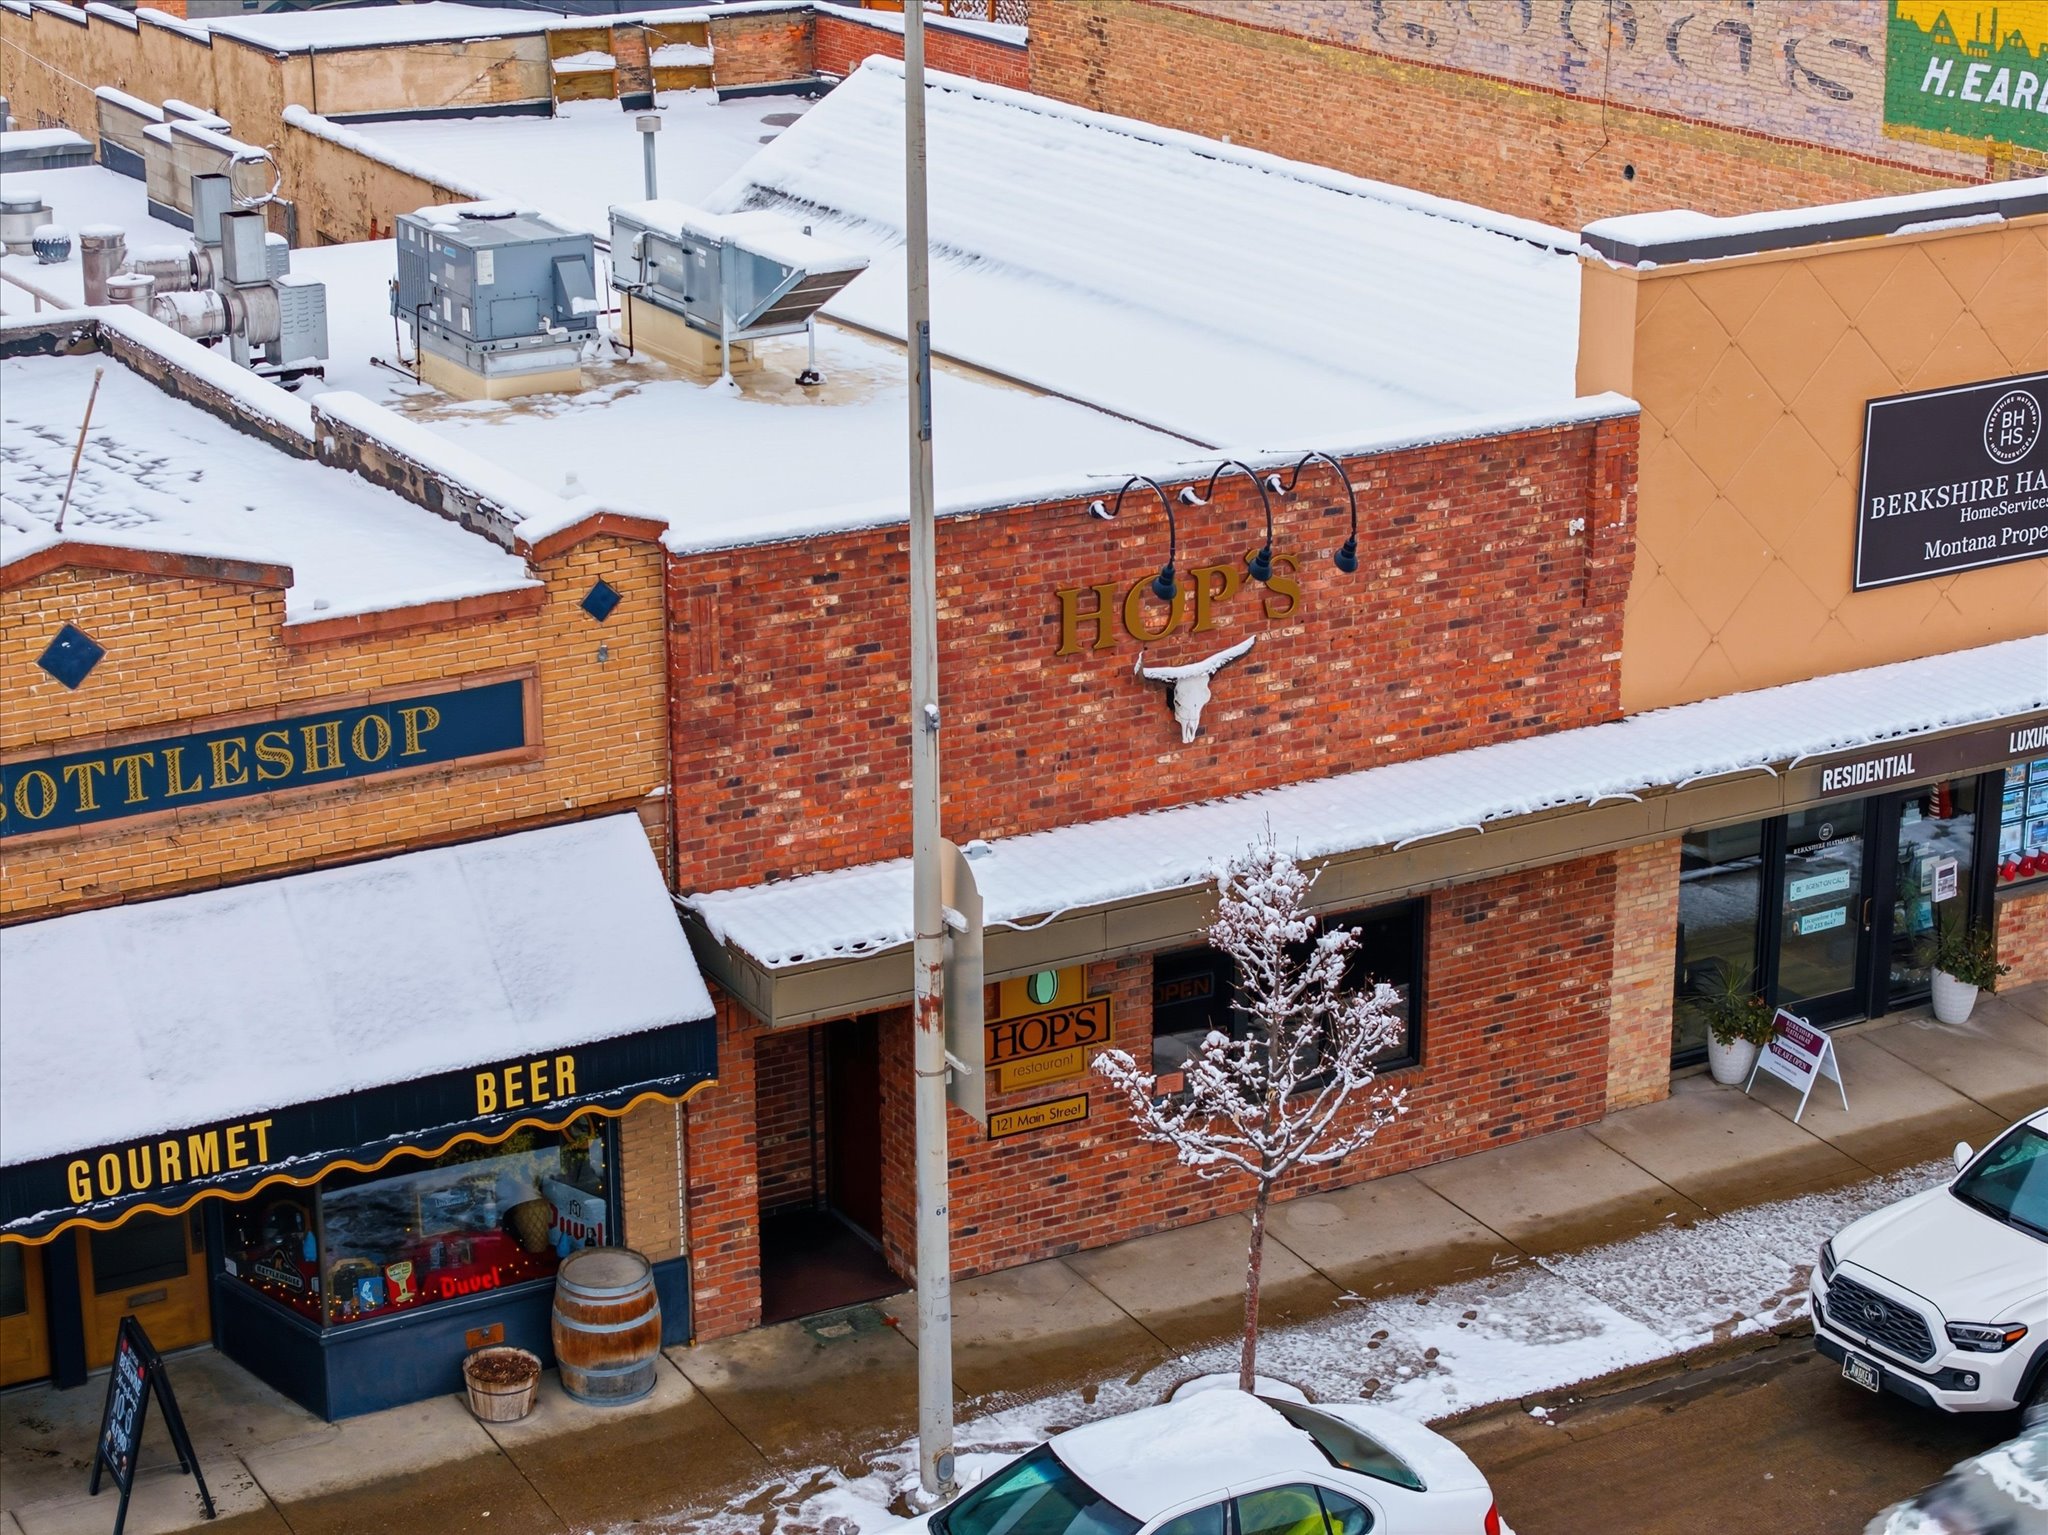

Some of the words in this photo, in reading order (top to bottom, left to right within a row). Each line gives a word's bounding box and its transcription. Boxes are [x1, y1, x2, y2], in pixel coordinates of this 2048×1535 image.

[2000, 427, 2023, 447] HS
[2002, 409, 2025, 429] BH
[1871, 475, 2009, 519] BERKSHIRE
[2014, 469, 2048, 494] HA
[1924, 534, 1997, 560] Montana
[2000, 525, 2048, 546] Prope
[1055, 550, 1300, 656] HOP'S
[0, 705, 441, 821] OTTLESHOP
[1822, 753, 1915, 791] RESIDENTIAL
[989, 1006, 1097, 1060] HOP'S
[1013, 1054, 1074, 1077] restaurant
[1783, 1050, 1792, 1063] ARE
[1793, 1055, 1807, 1069] OPEN
[476, 1055, 577, 1115] BEER
[996, 1117, 1014, 1132] 121
[1017, 1112, 1045, 1128] Main
[1050, 1103, 1081, 1120] Street
[68, 1119, 273, 1204] GOURMET
[440, 1265, 500, 1298] Duvel
